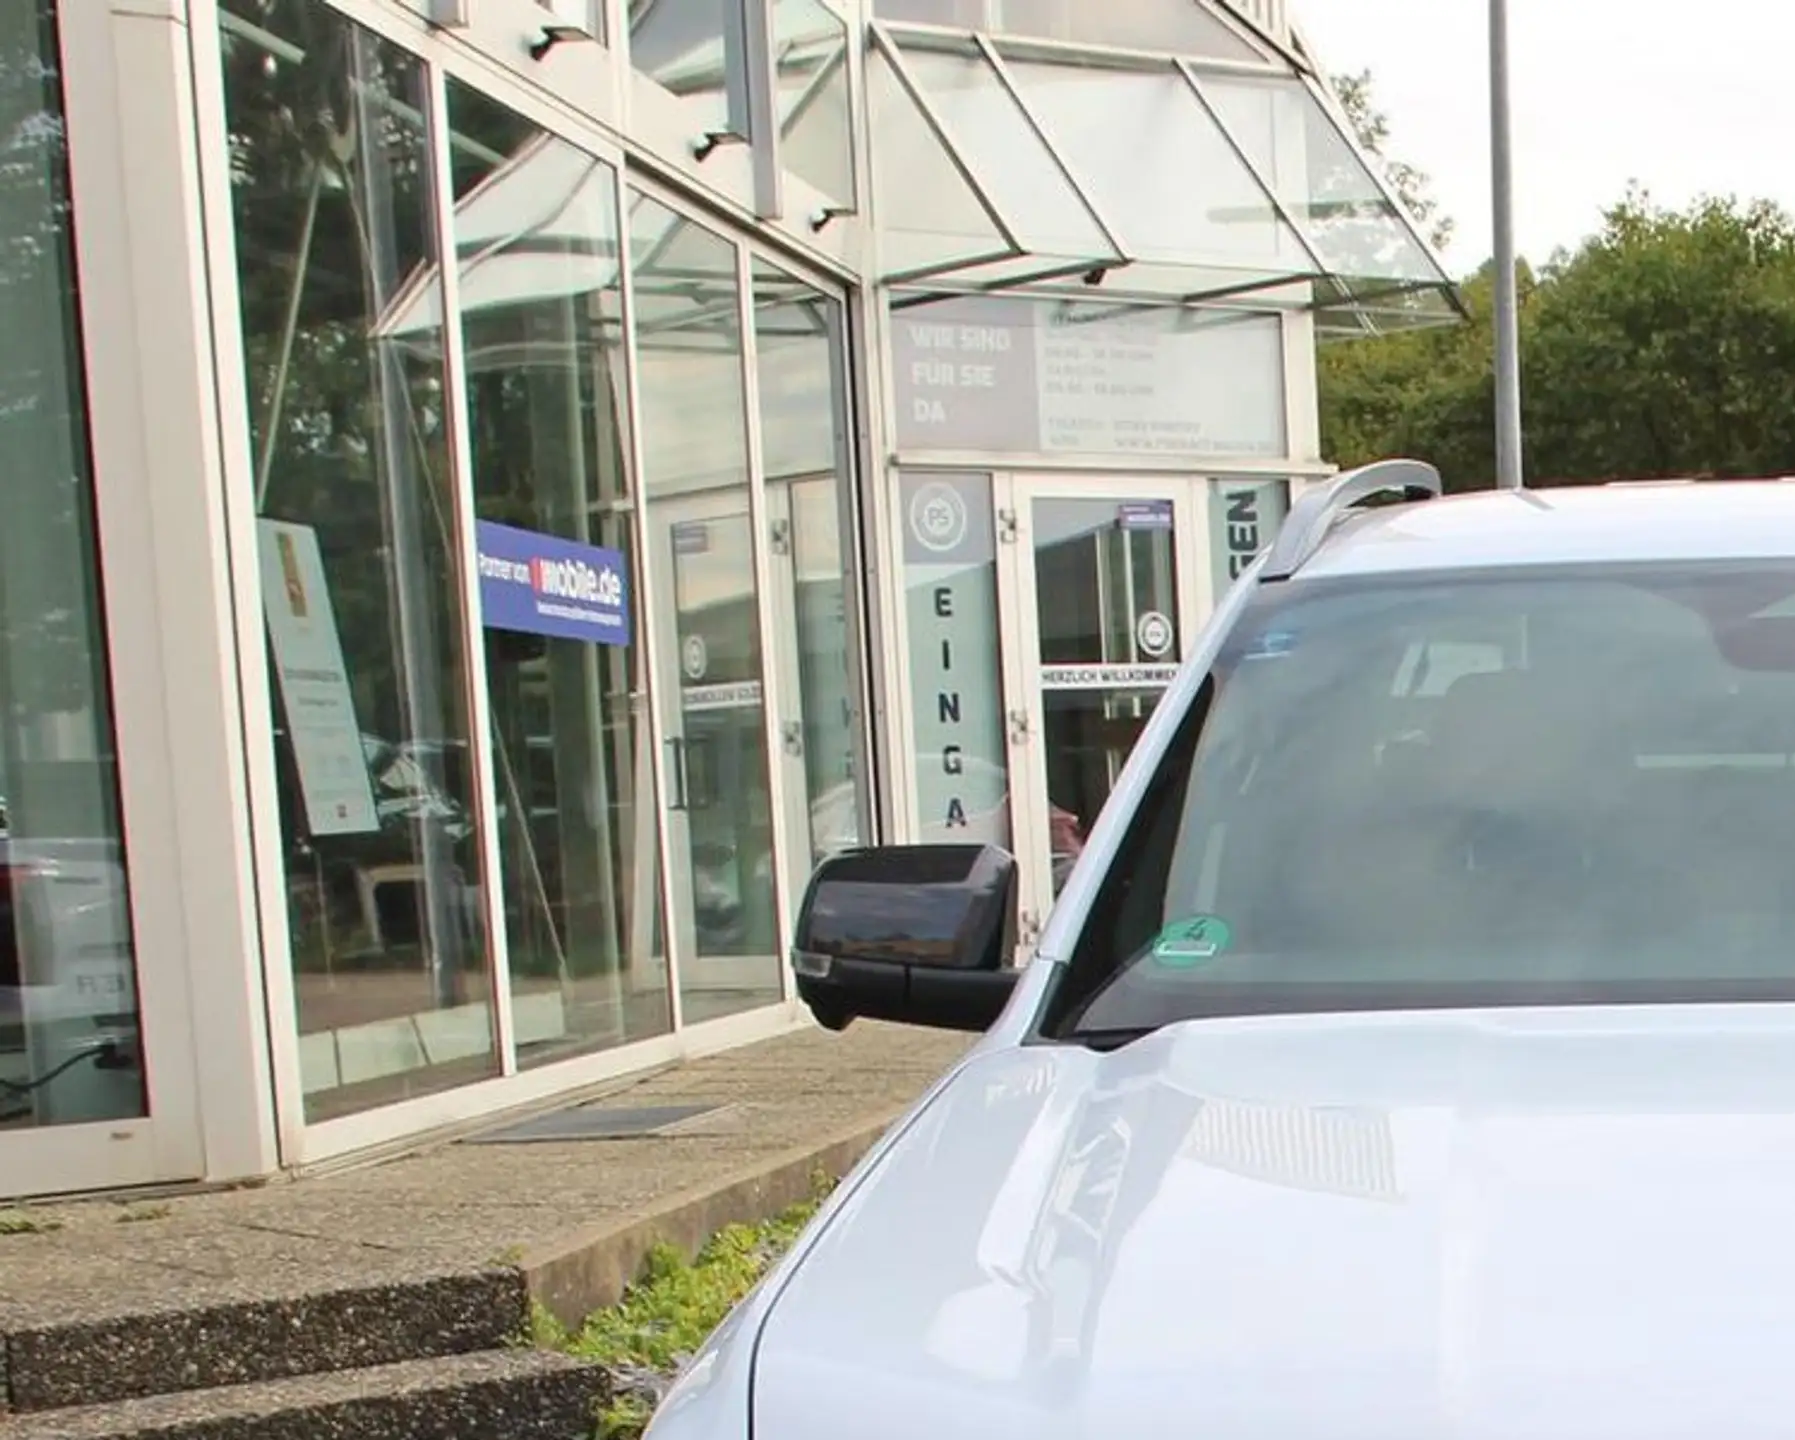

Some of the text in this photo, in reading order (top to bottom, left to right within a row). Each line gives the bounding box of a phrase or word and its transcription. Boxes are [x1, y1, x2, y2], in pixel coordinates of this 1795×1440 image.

[908, 325, 1012, 351] WIR SIND
[911, 358, 997, 387] FÜR SIE
[913, 399, 946, 423] DA
[539, 557, 621, 607] mobile.de
[1041, 669, 1096, 684] HERZLICH
